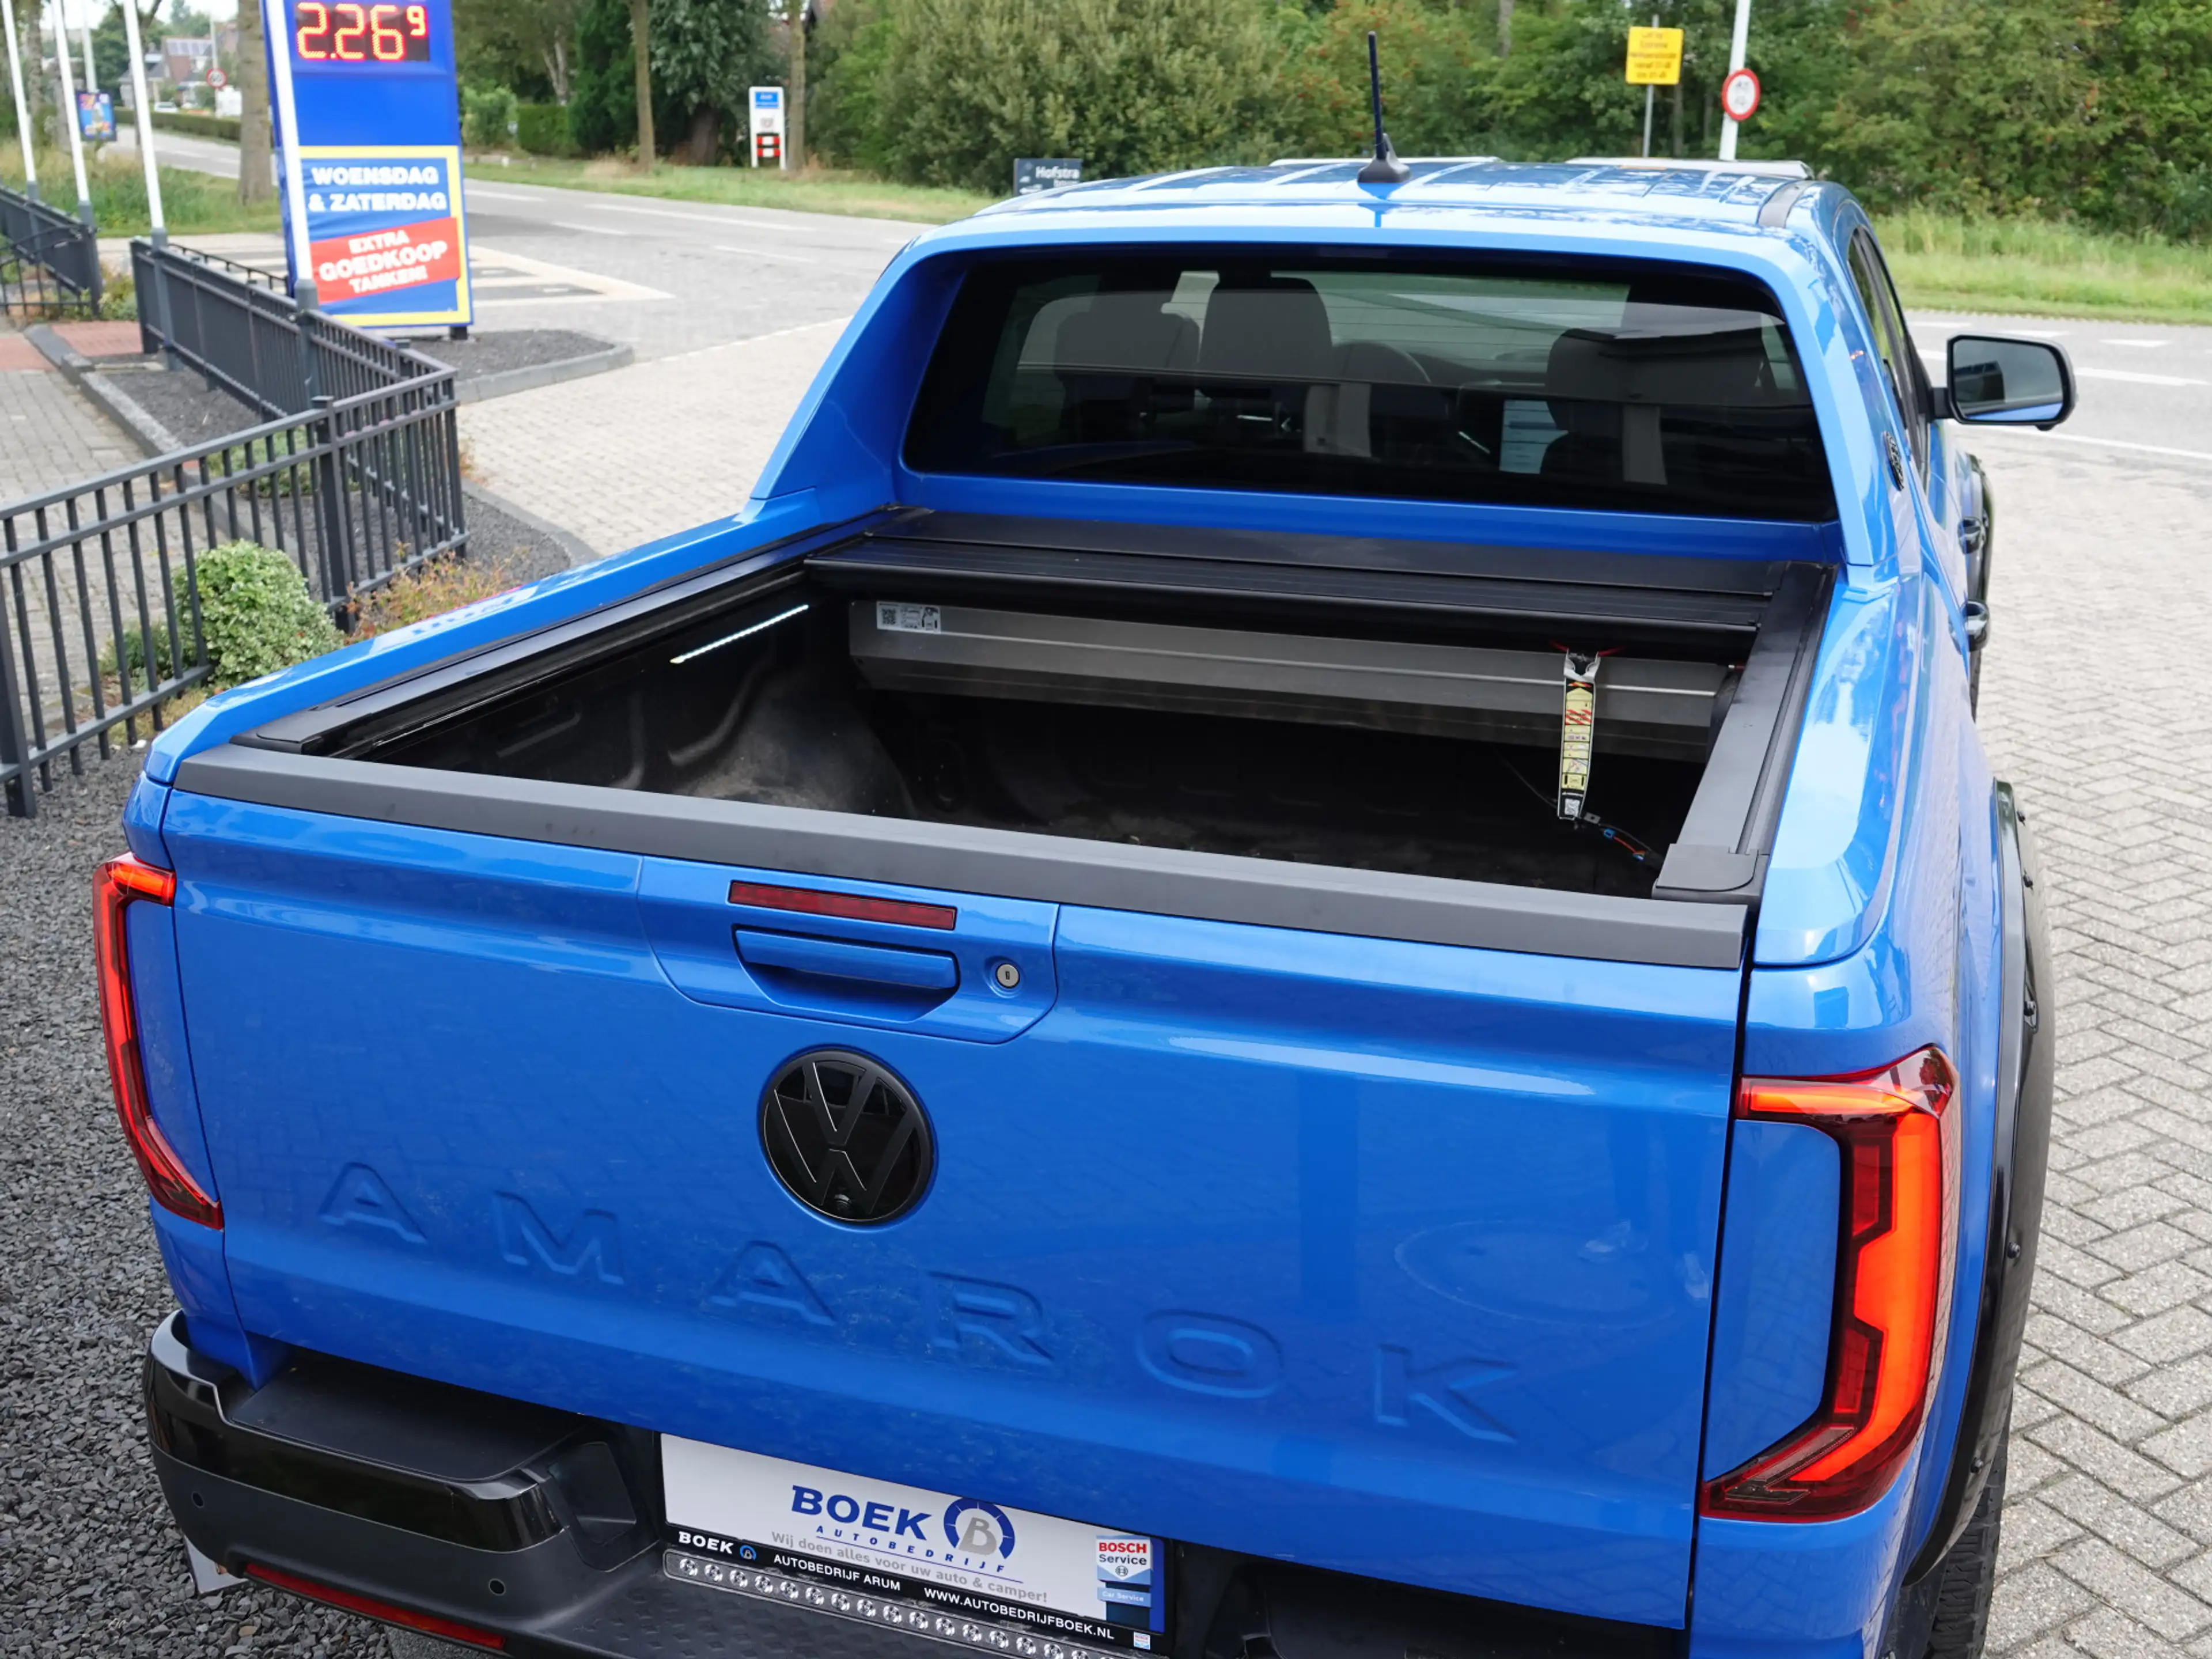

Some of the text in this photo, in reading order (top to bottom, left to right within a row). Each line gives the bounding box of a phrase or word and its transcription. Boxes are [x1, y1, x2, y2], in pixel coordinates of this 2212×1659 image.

[312, 166, 440, 185] WOENSDAG
[308, 191, 448, 212] & ZATERDAG
[348, 229, 410, 255] EXTRA
[319, 240, 448, 282] GOEDKOOP
[349, 264, 429, 294] TANKEN!
[318, 1161, 1518, 1443] AMAROK
[791, 1485, 932, 1541] BOEK
[679, 1531, 734, 1554] BOEK
[816, 1525, 1005, 1573] AUTOBEDRIJF
[1099, 1542, 1147, 1554] BOSCH
[772, 1531, 1047, 1603] Wij doen alles voor uw auto & camper!
[774, 1554, 901, 1591] AUTOBEDRIJF ARUM
[1099, 1554, 1147, 1566] Service
[1116, 1592, 1145, 1603] Service
[924, 1587, 1115, 1640] WWW.AUTOBEDRIJFBOEK.NL
